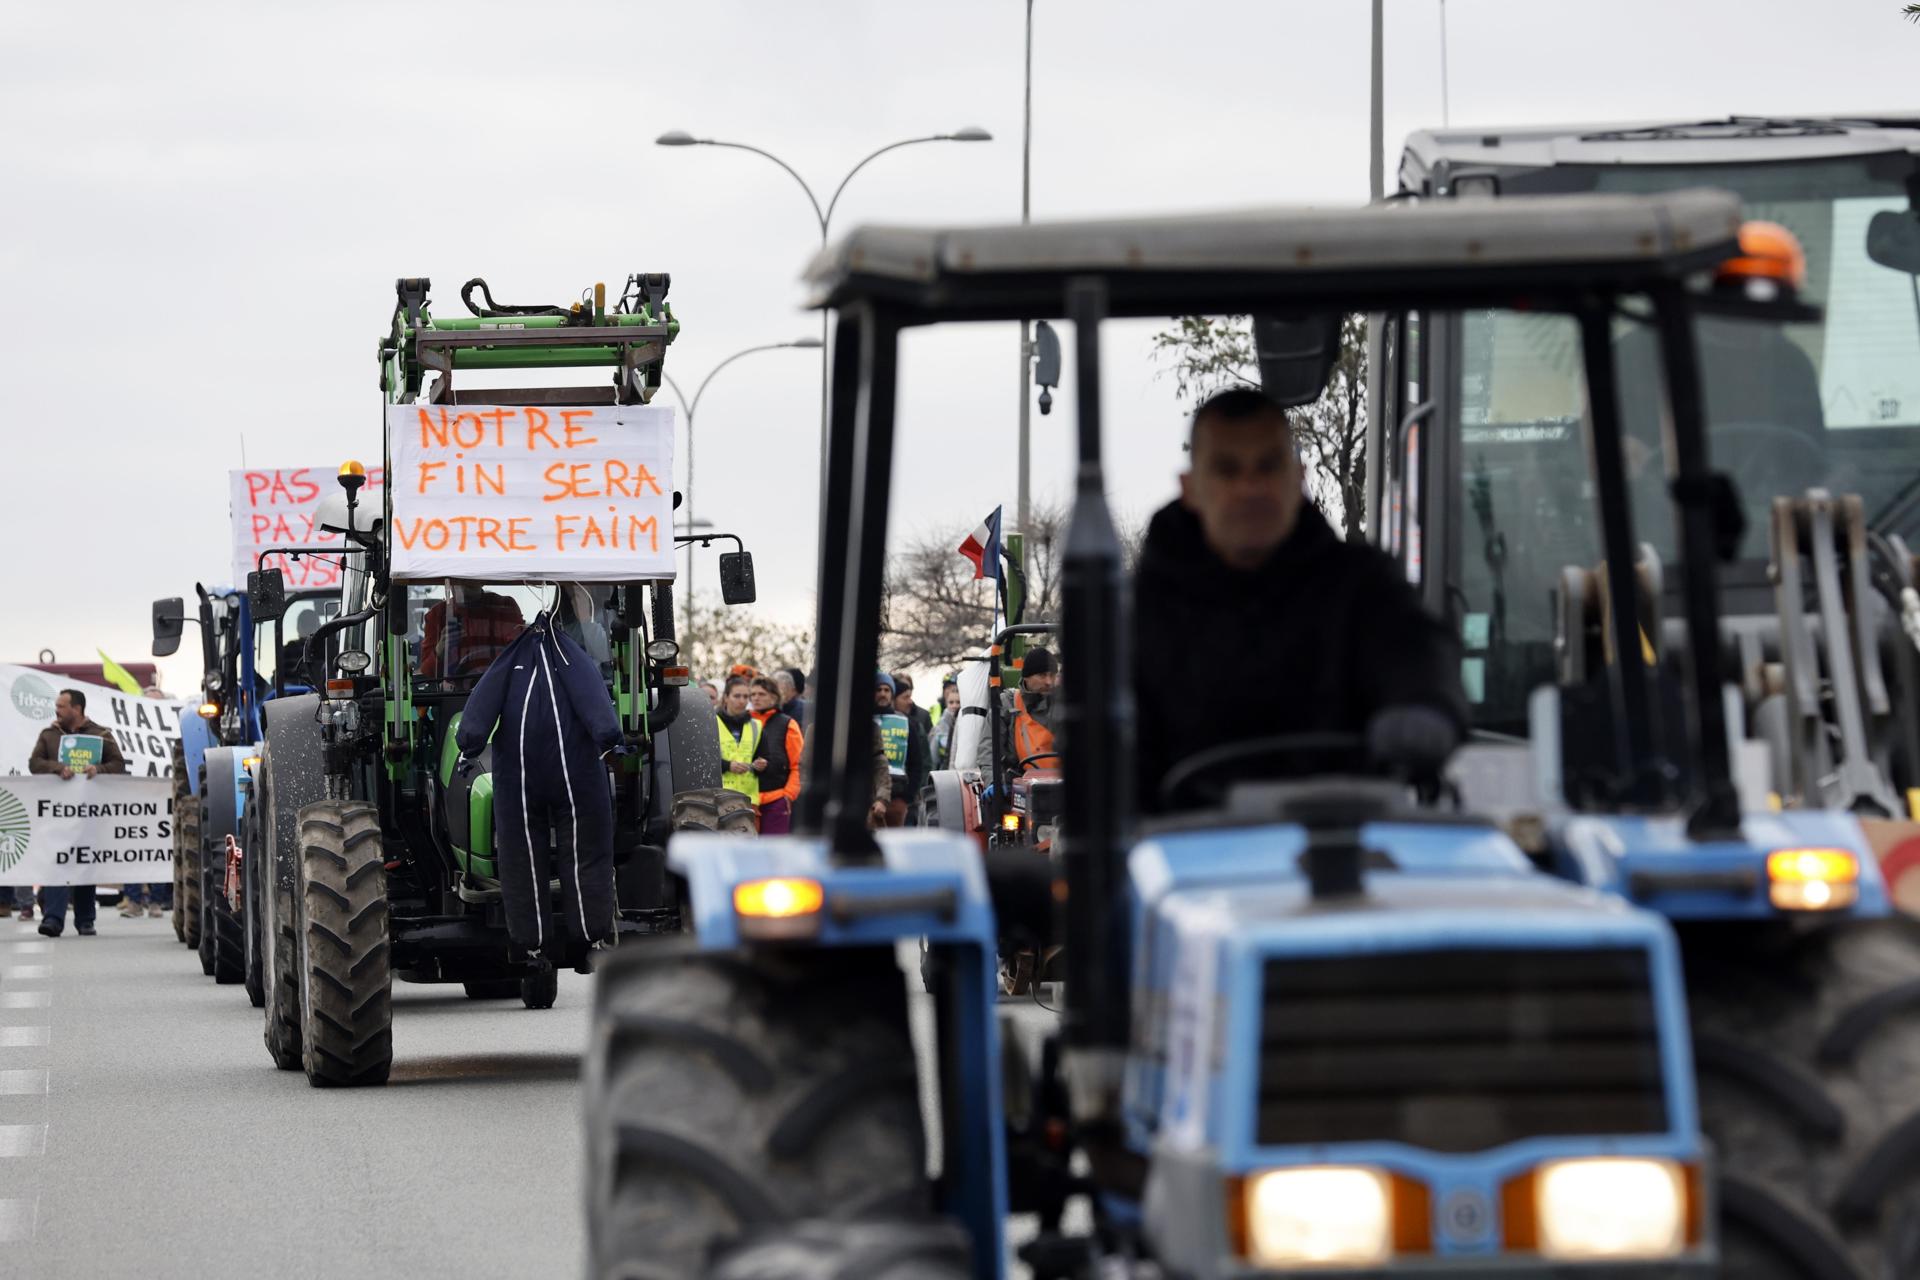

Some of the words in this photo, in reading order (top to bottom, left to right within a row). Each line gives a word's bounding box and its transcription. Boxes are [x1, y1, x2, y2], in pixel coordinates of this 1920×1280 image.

[417, 407, 597, 451] NOTRE
[244, 468, 321, 507] PAS
[543, 458, 663, 502] SERA
[251, 513, 337, 544] PAY
[392, 516, 537, 553] VOTRE
